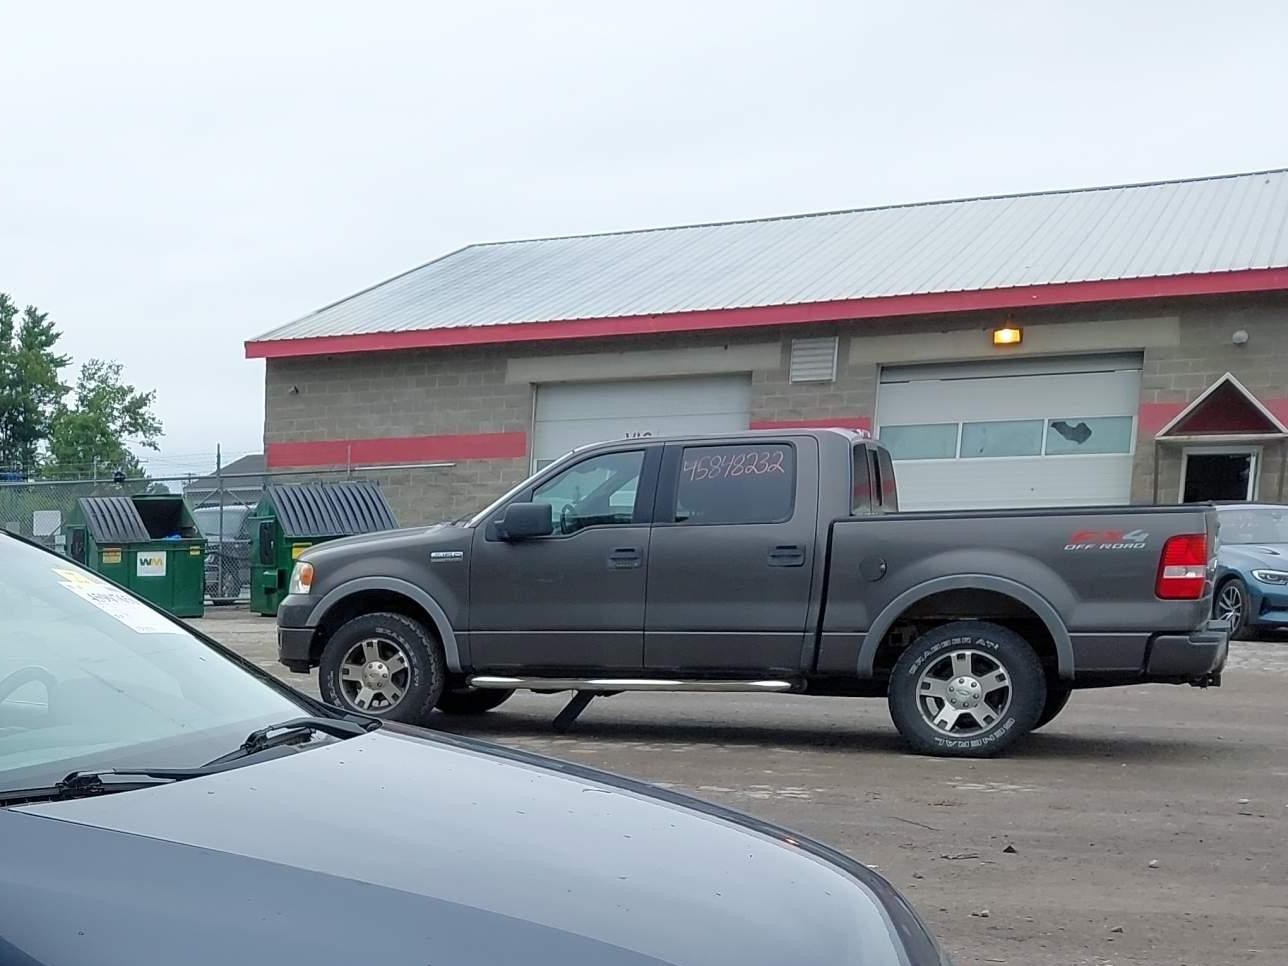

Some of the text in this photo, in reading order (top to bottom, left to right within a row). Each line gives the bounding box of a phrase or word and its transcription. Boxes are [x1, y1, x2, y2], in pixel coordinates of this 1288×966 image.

[683, 450, 785, 481] 45848232
[1063, 542, 1146, 551] OFF ROAD
[139, 557, 163, 567] WM
